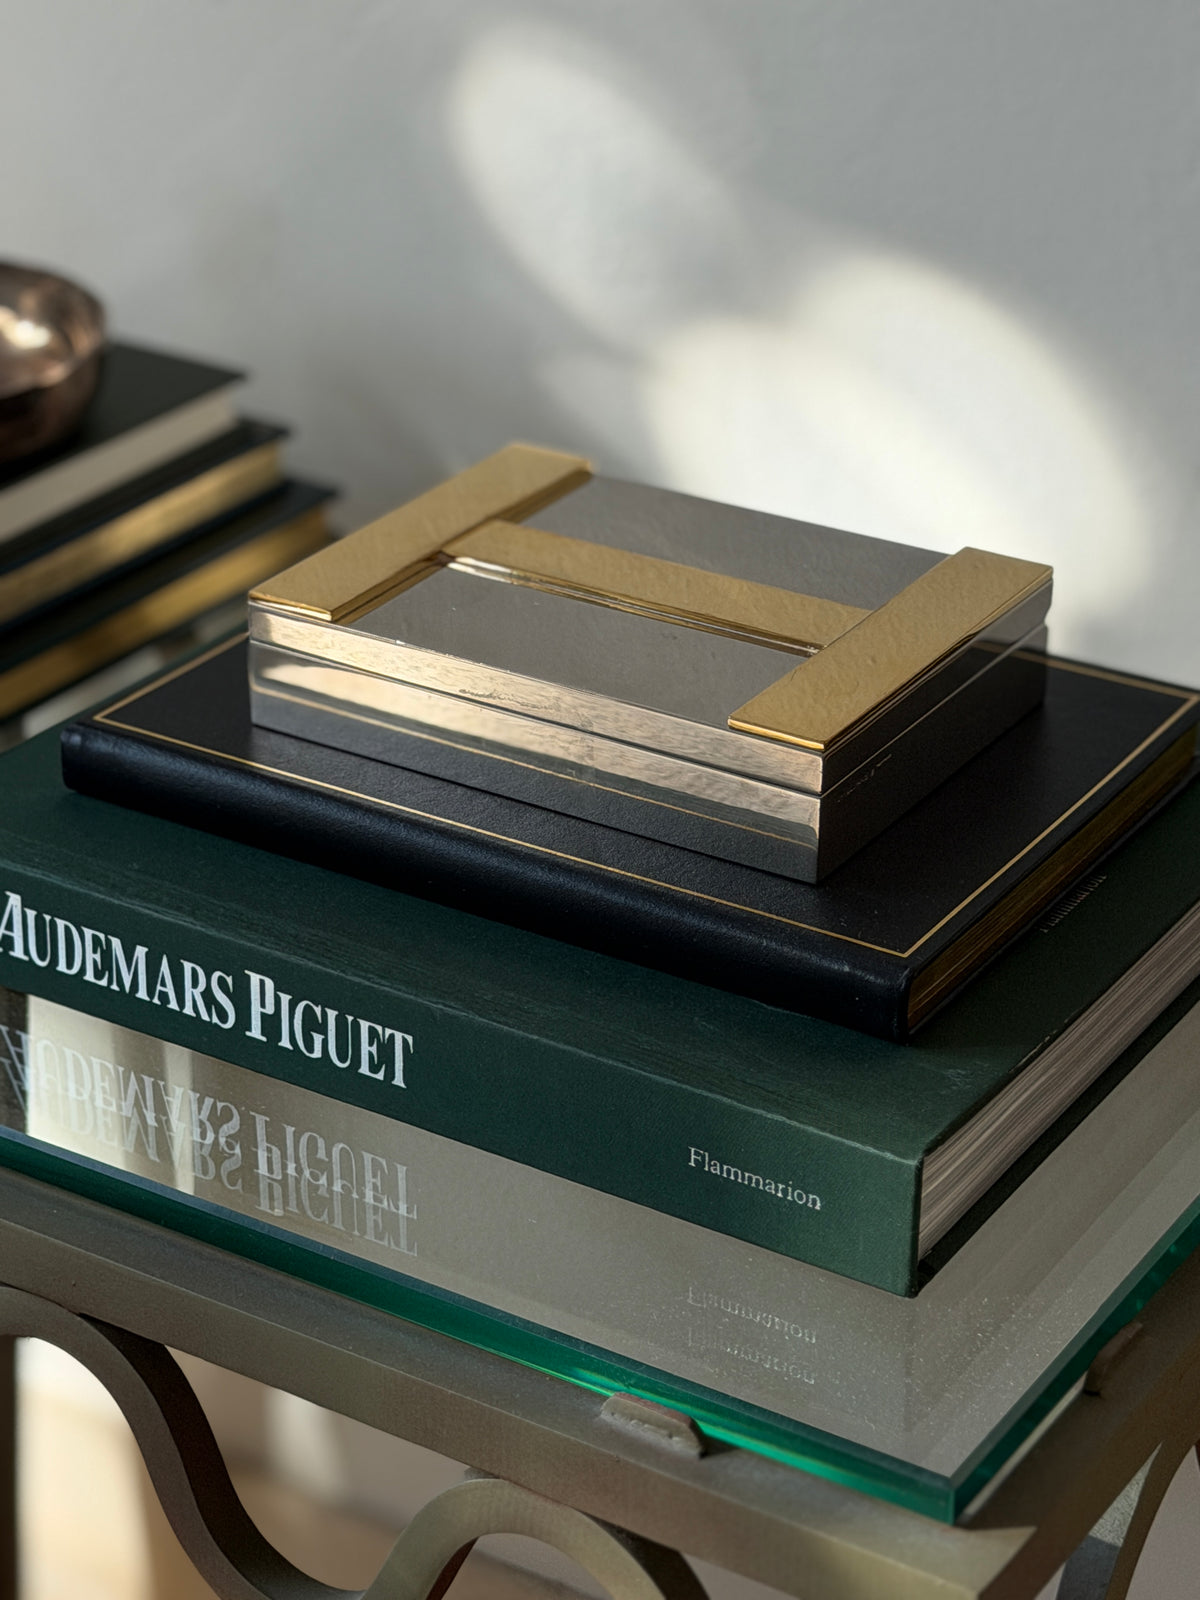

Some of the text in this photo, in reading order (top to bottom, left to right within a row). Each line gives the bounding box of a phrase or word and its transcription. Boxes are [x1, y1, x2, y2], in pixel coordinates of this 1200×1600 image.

[0, 890, 413, 1089] AUDEMARS PIGUET
[688, 1146, 821, 1210] Flammarion
